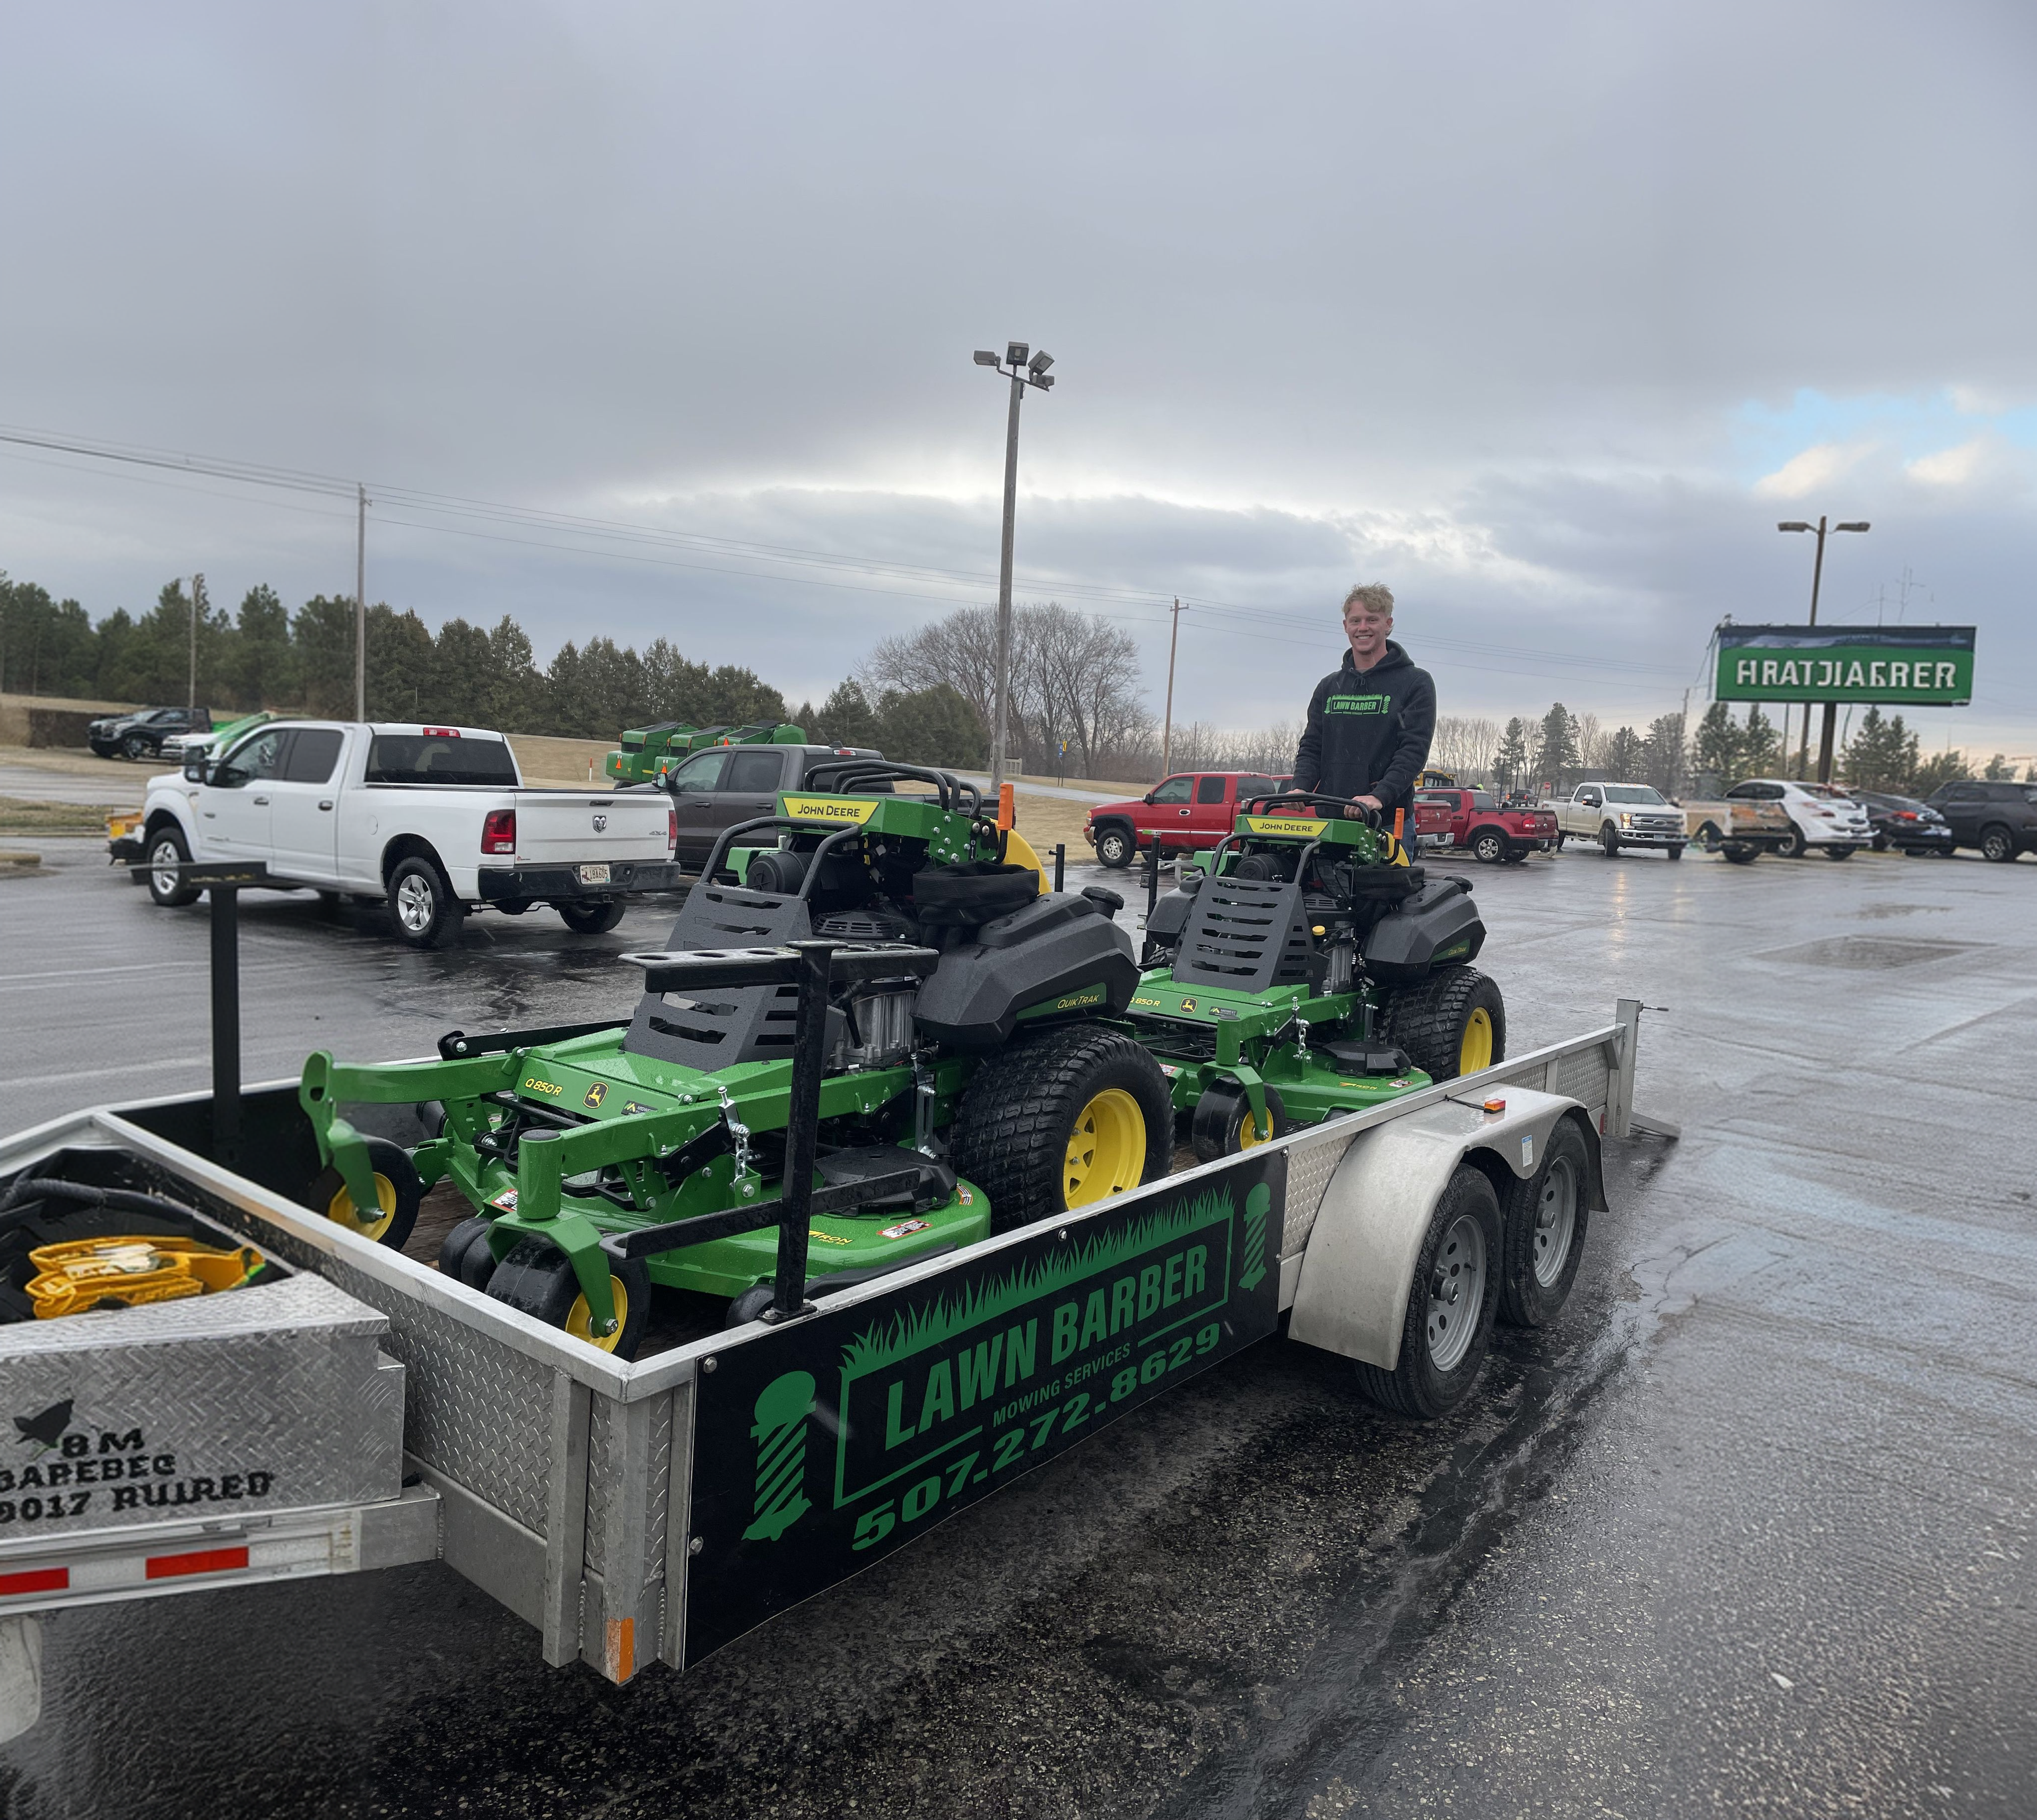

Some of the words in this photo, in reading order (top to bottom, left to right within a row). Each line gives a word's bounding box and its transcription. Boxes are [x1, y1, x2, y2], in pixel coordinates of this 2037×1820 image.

[1333, 701, 1351, 710] LAWN
[1350, 701, 1377, 711] BARBER
[797, 804, 824, 815] JOHN
[826, 805, 860, 817] DEERE
[1284, 823, 1313, 832] DEERE
[885, 1317, 1038, 1451] LAWN
[1051, 1244, 1207, 1366] BARBER
[993, 1380, 1060, 1427] MOWING
[1065, 1342, 1130, 1389] SERVICES
[852, 1323, 1220, 1551] 507.272.8629
